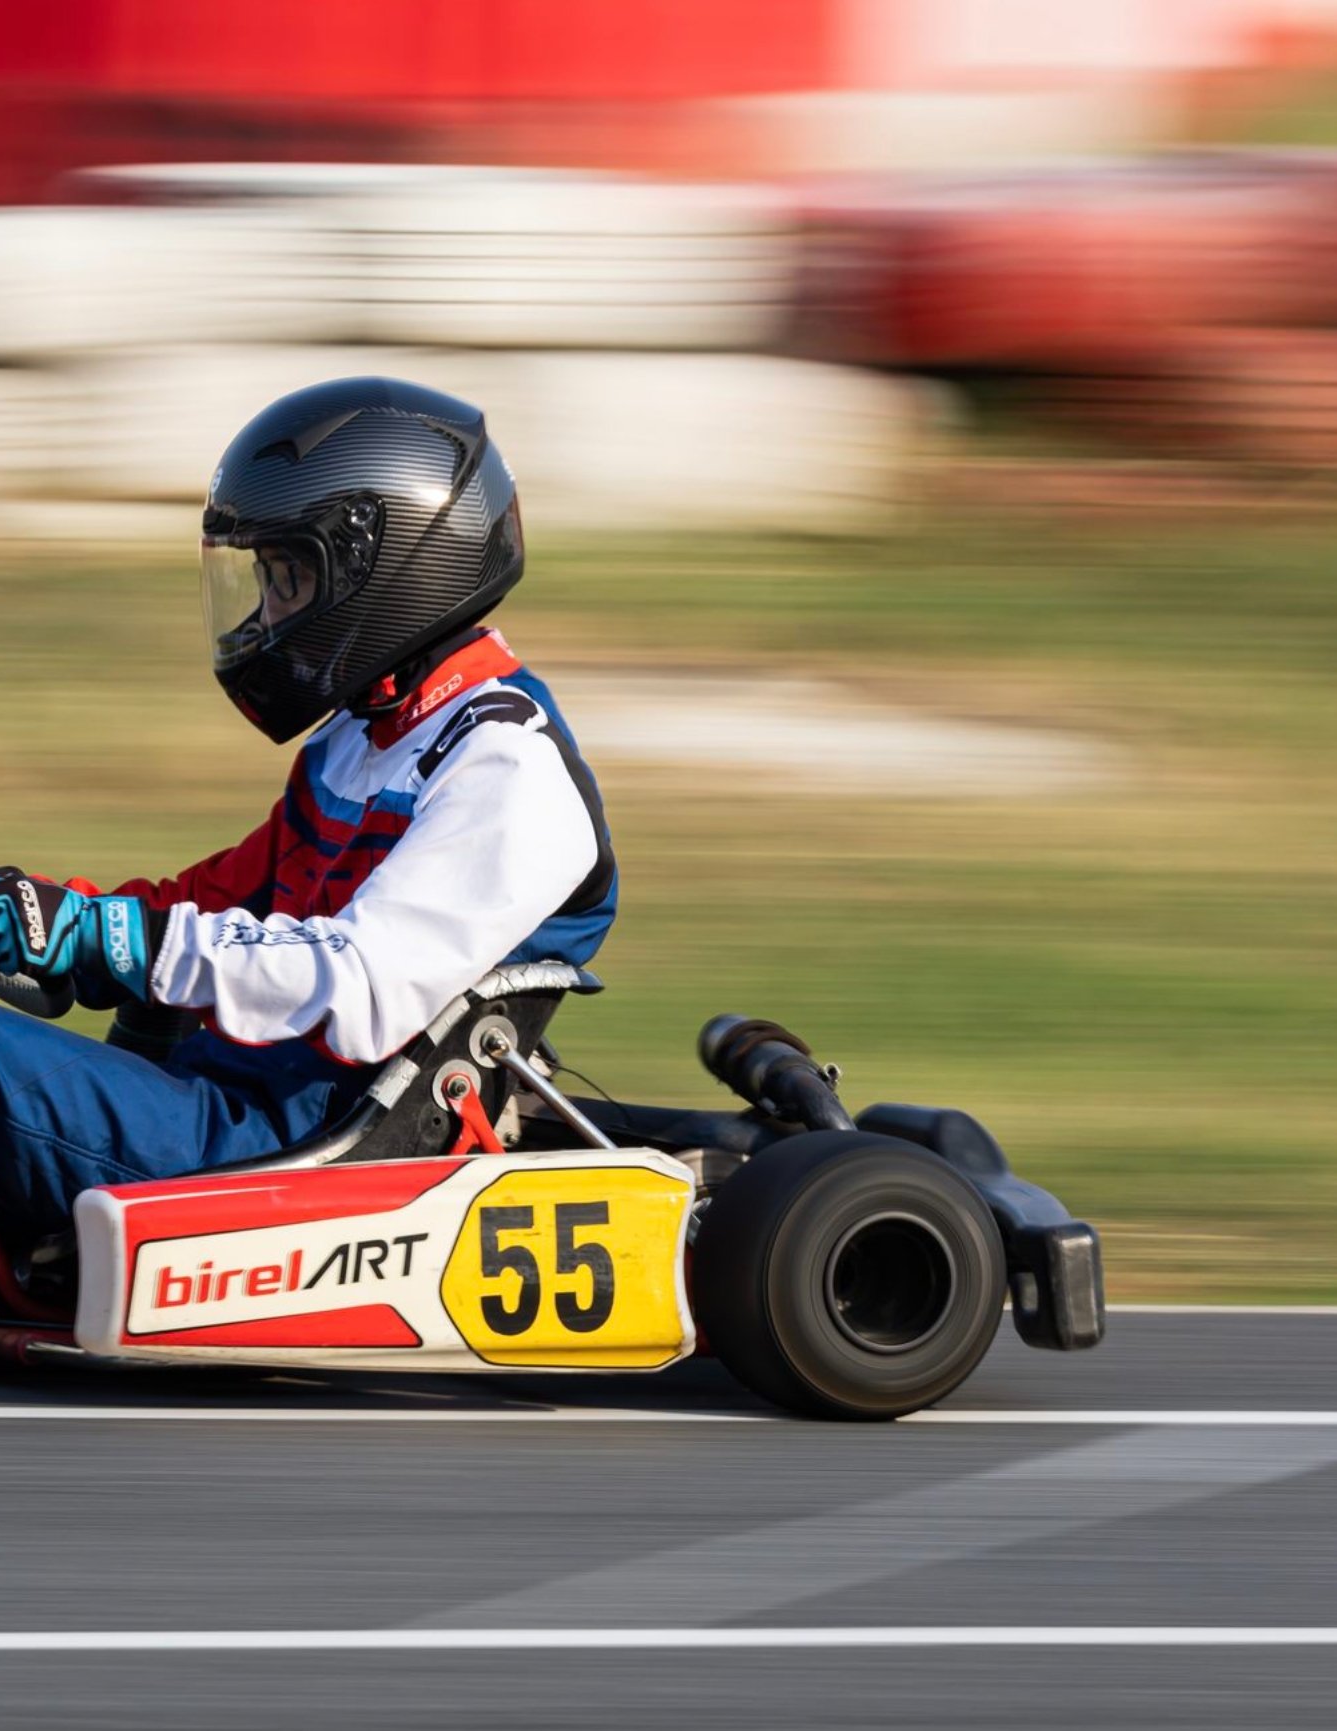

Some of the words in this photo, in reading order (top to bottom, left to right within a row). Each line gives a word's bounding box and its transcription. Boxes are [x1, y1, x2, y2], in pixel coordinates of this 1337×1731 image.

[17, 880, 47, 950] sparco
[107, 901, 135, 974] sparco
[153, 1232, 428, 1309] birelART
[479, 1200, 615, 1336] 55
